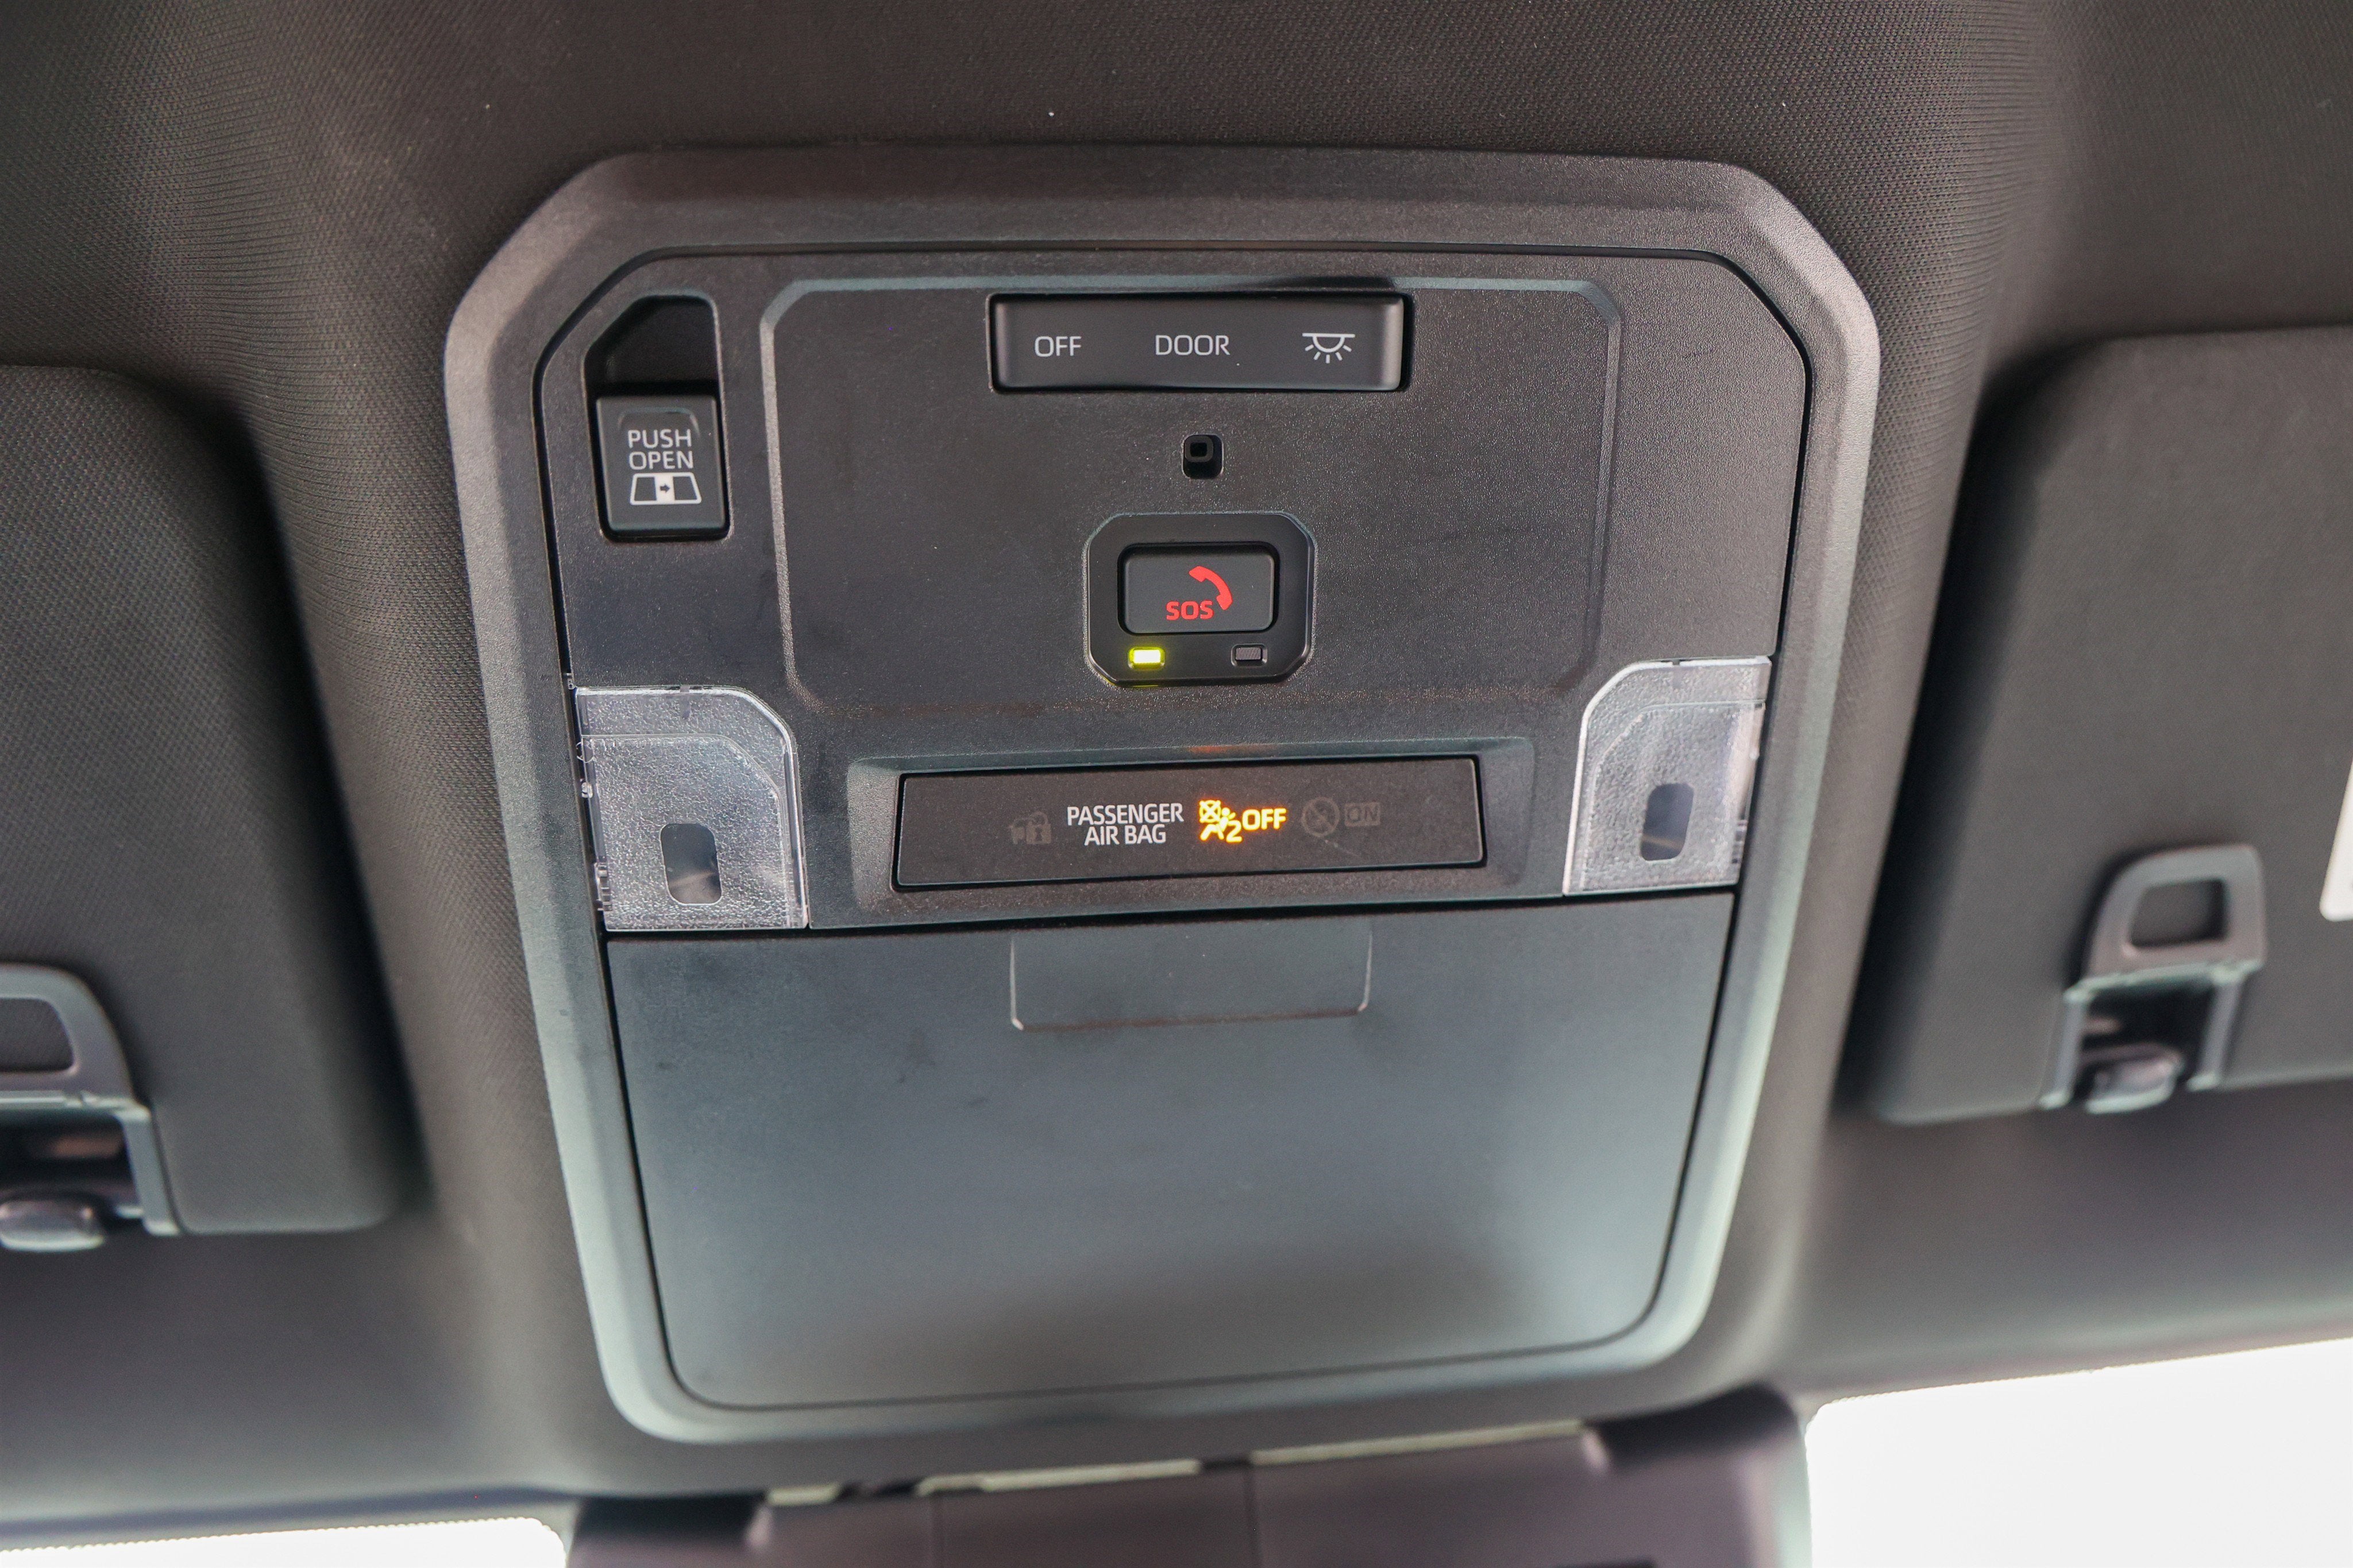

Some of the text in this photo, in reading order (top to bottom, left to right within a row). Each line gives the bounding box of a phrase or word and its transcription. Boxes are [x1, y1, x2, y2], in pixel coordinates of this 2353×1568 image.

[1033, 335, 1082, 357] OFF
[1155, 335, 1230, 356] DOOR
[627, 428, 692, 449] PUSH
[628, 450, 694, 470] OPEN
[1166, 600, 1214, 621] SOS
[1067, 802, 1185, 826] PASSENGER
[1242, 808, 1287, 831] OFF
[1084, 823, 1167, 847] AIR BAG
